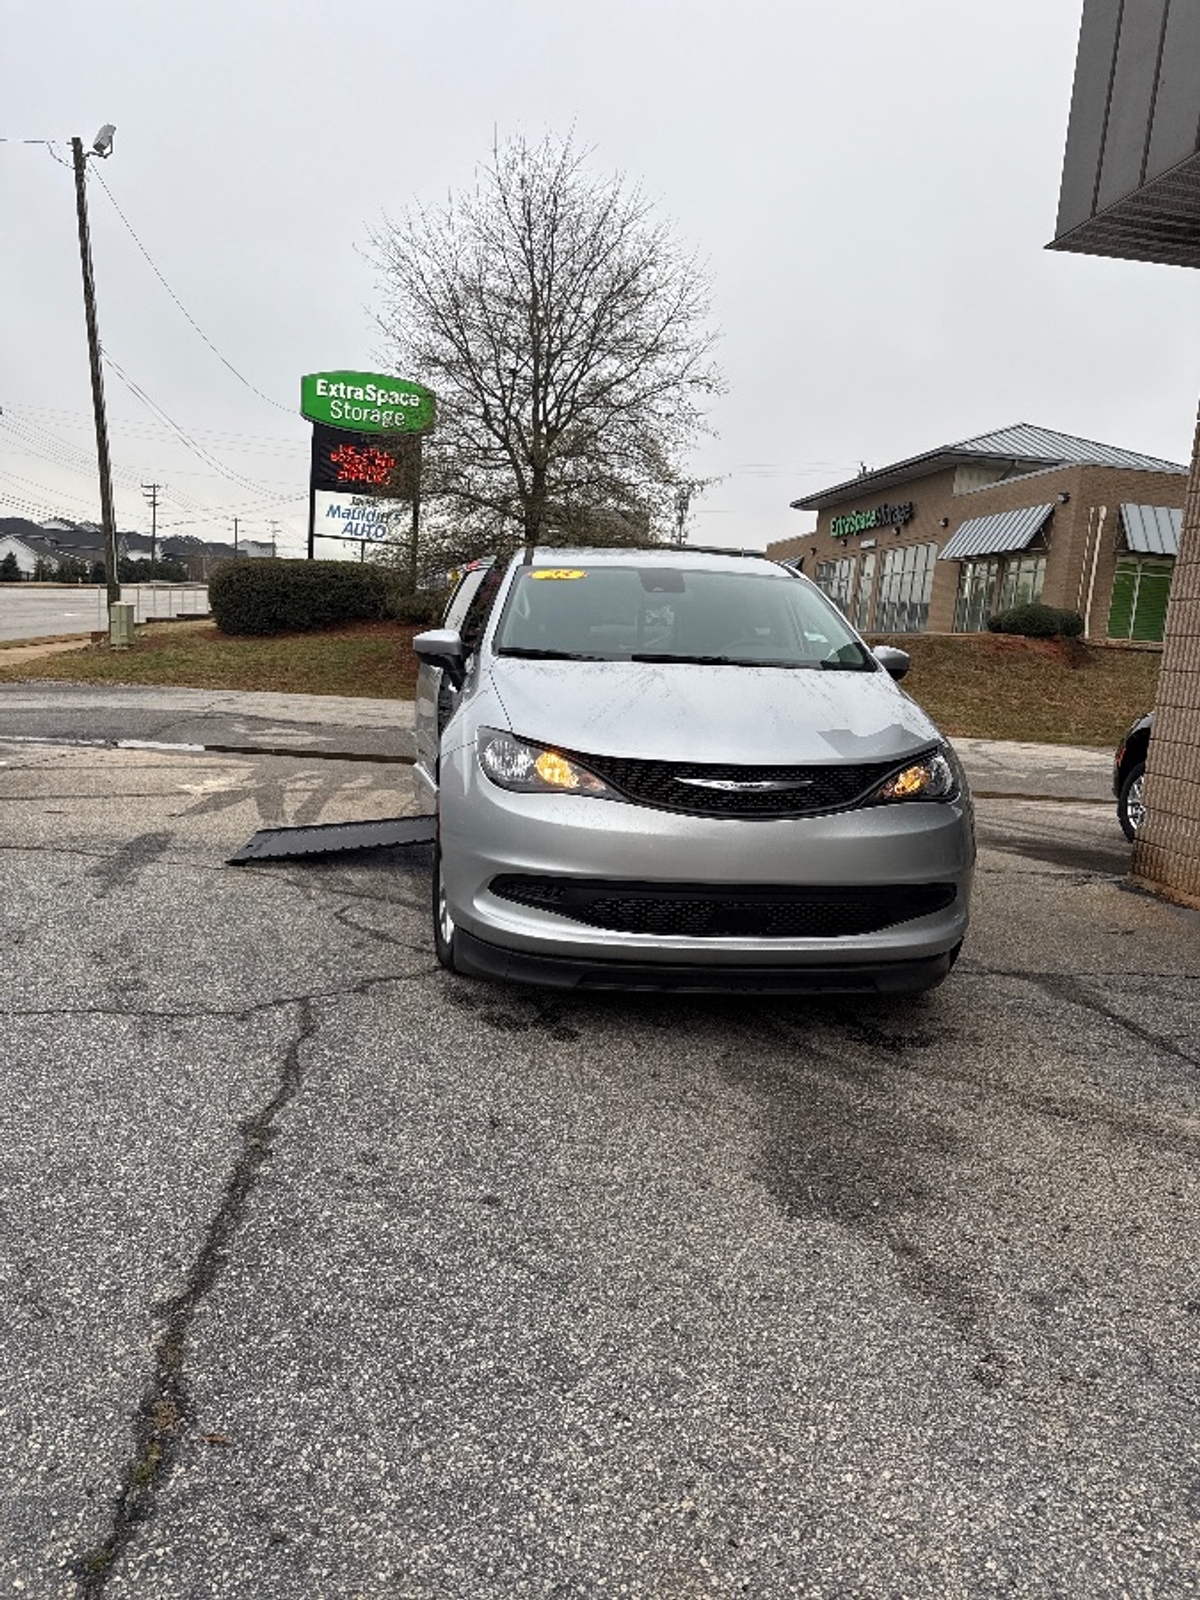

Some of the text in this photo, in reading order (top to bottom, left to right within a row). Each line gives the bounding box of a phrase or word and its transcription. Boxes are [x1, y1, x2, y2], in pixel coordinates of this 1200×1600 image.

[316, 379, 420, 406] ExtraSpace
[330, 400, 405, 427] Storage
[325, 504, 404, 524] Mauldins
[342, 521, 386, 538] AUTO
